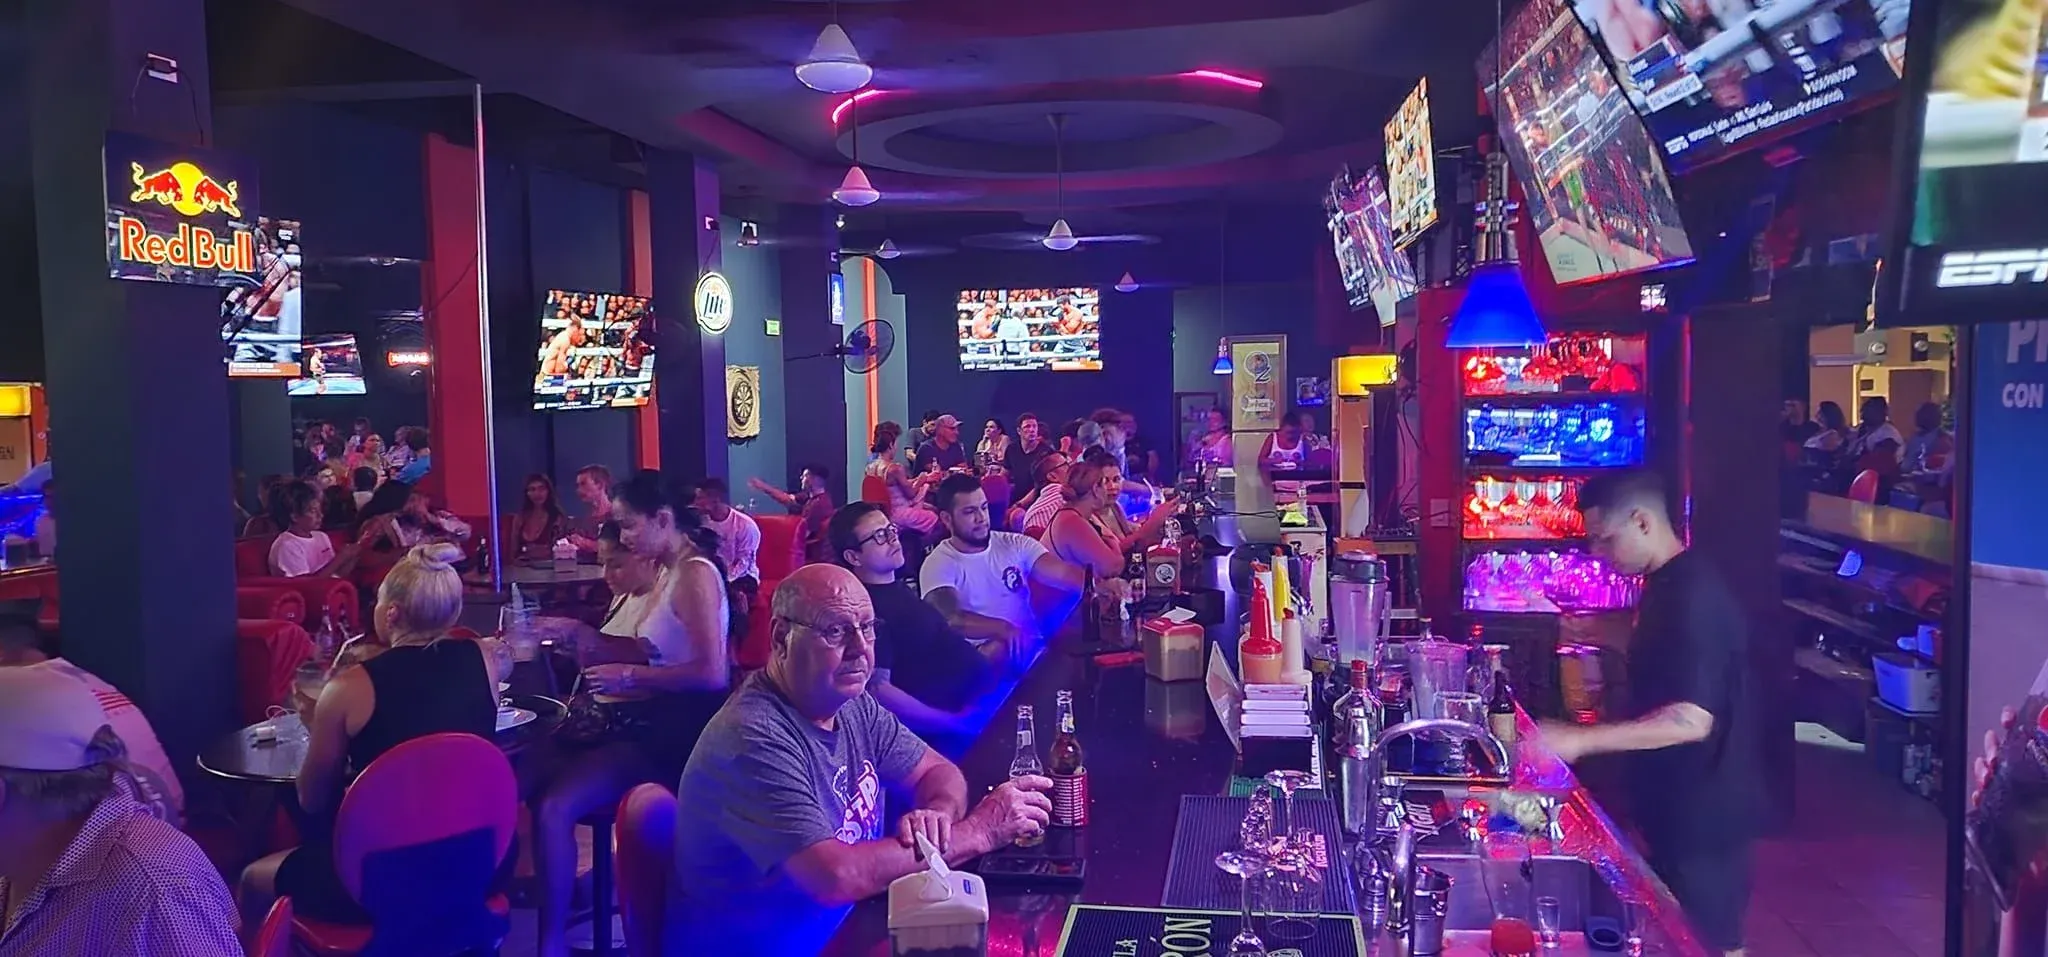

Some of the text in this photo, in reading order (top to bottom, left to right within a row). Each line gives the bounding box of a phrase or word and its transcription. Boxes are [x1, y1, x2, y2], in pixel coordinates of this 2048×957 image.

[119, 217, 254, 272] Red Bull
[2002, 383, 2044, 409] CON
[1112, 938, 1138, 957] LA
